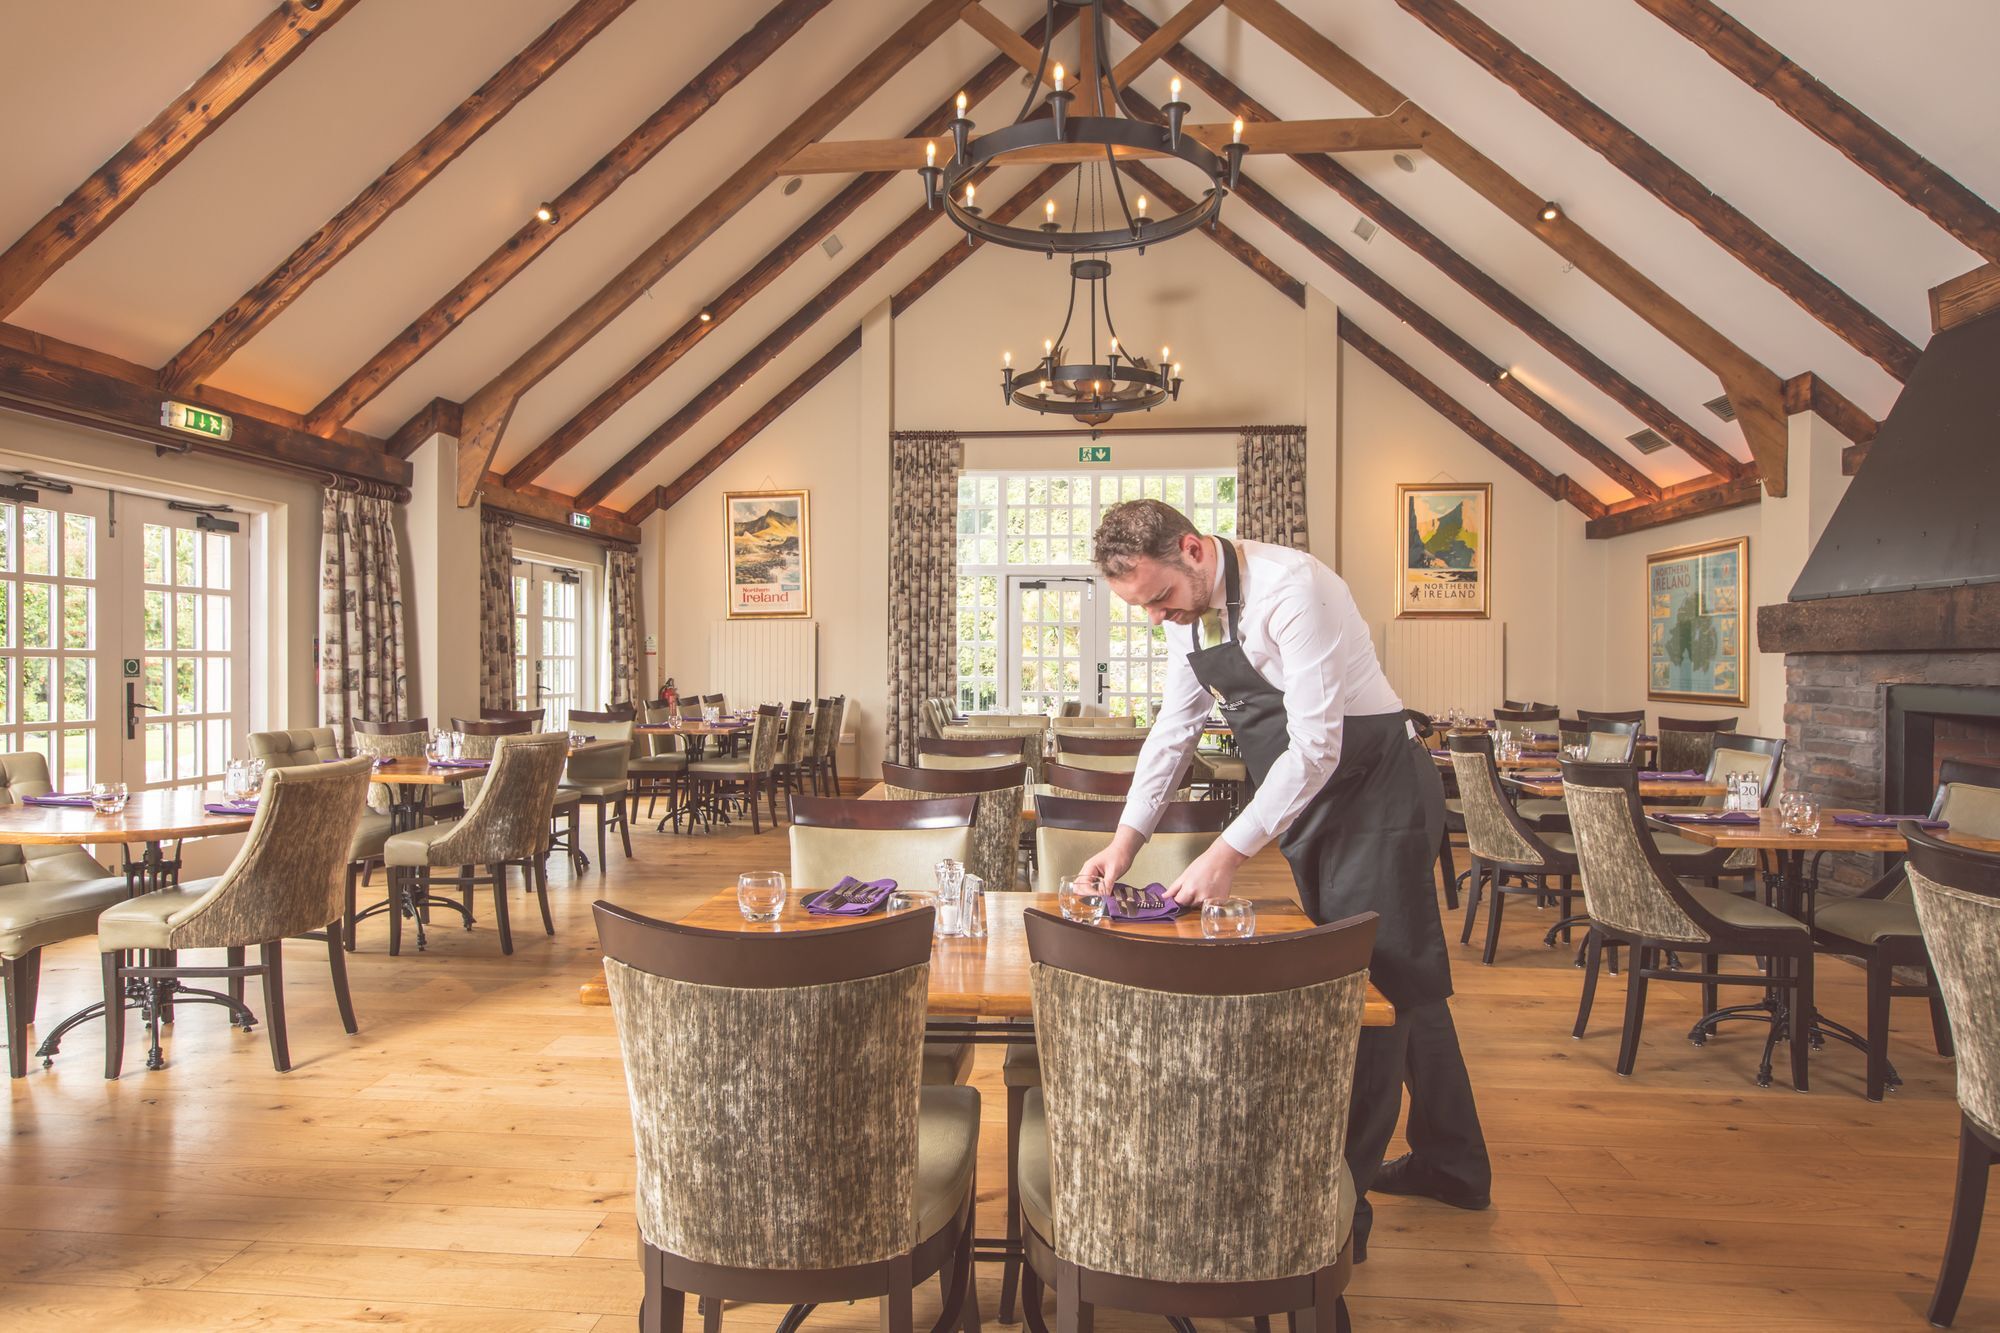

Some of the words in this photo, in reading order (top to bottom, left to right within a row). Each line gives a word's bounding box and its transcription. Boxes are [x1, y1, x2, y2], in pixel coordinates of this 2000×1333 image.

[1653, 573, 1691, 592] IRELAND
[743, 592, 789, 603] Ireland
[1424, 590, 1476, 599] IRELAND
[1741, 785, 1757, 796] 20
